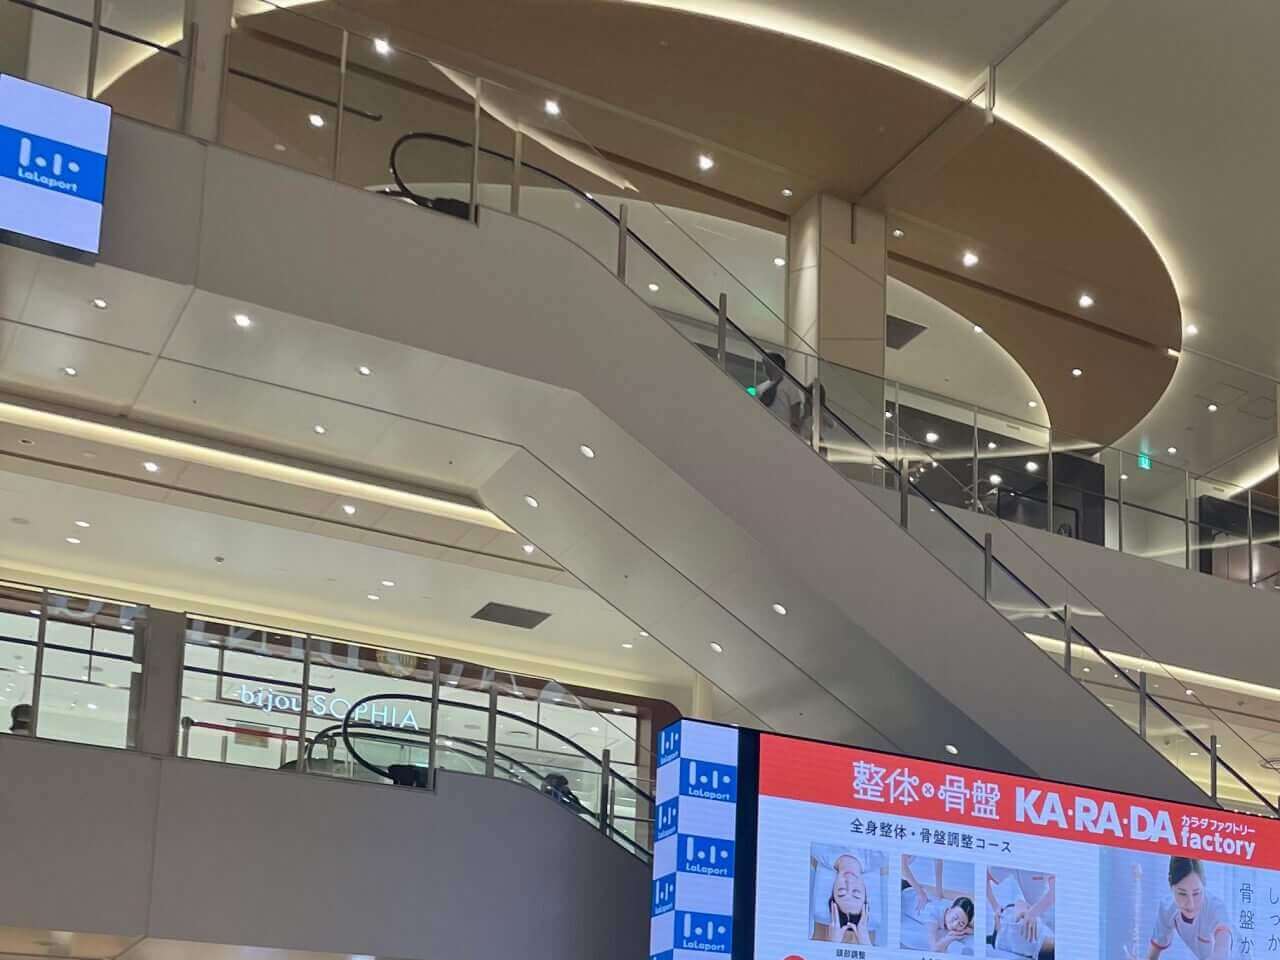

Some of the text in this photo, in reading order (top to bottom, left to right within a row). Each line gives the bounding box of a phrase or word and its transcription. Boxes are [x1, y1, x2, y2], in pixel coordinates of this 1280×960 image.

[18, 167, 78, 192] LaLaport
[238, 684, 420, 730] bijou SOPHIA
[688, 786, 730, 800] LaLaport
[1180, 831, 1257, 861] factory
[686, 862, 728, 876] LaLaport
[683, 939, 725, 952] LaLaport
